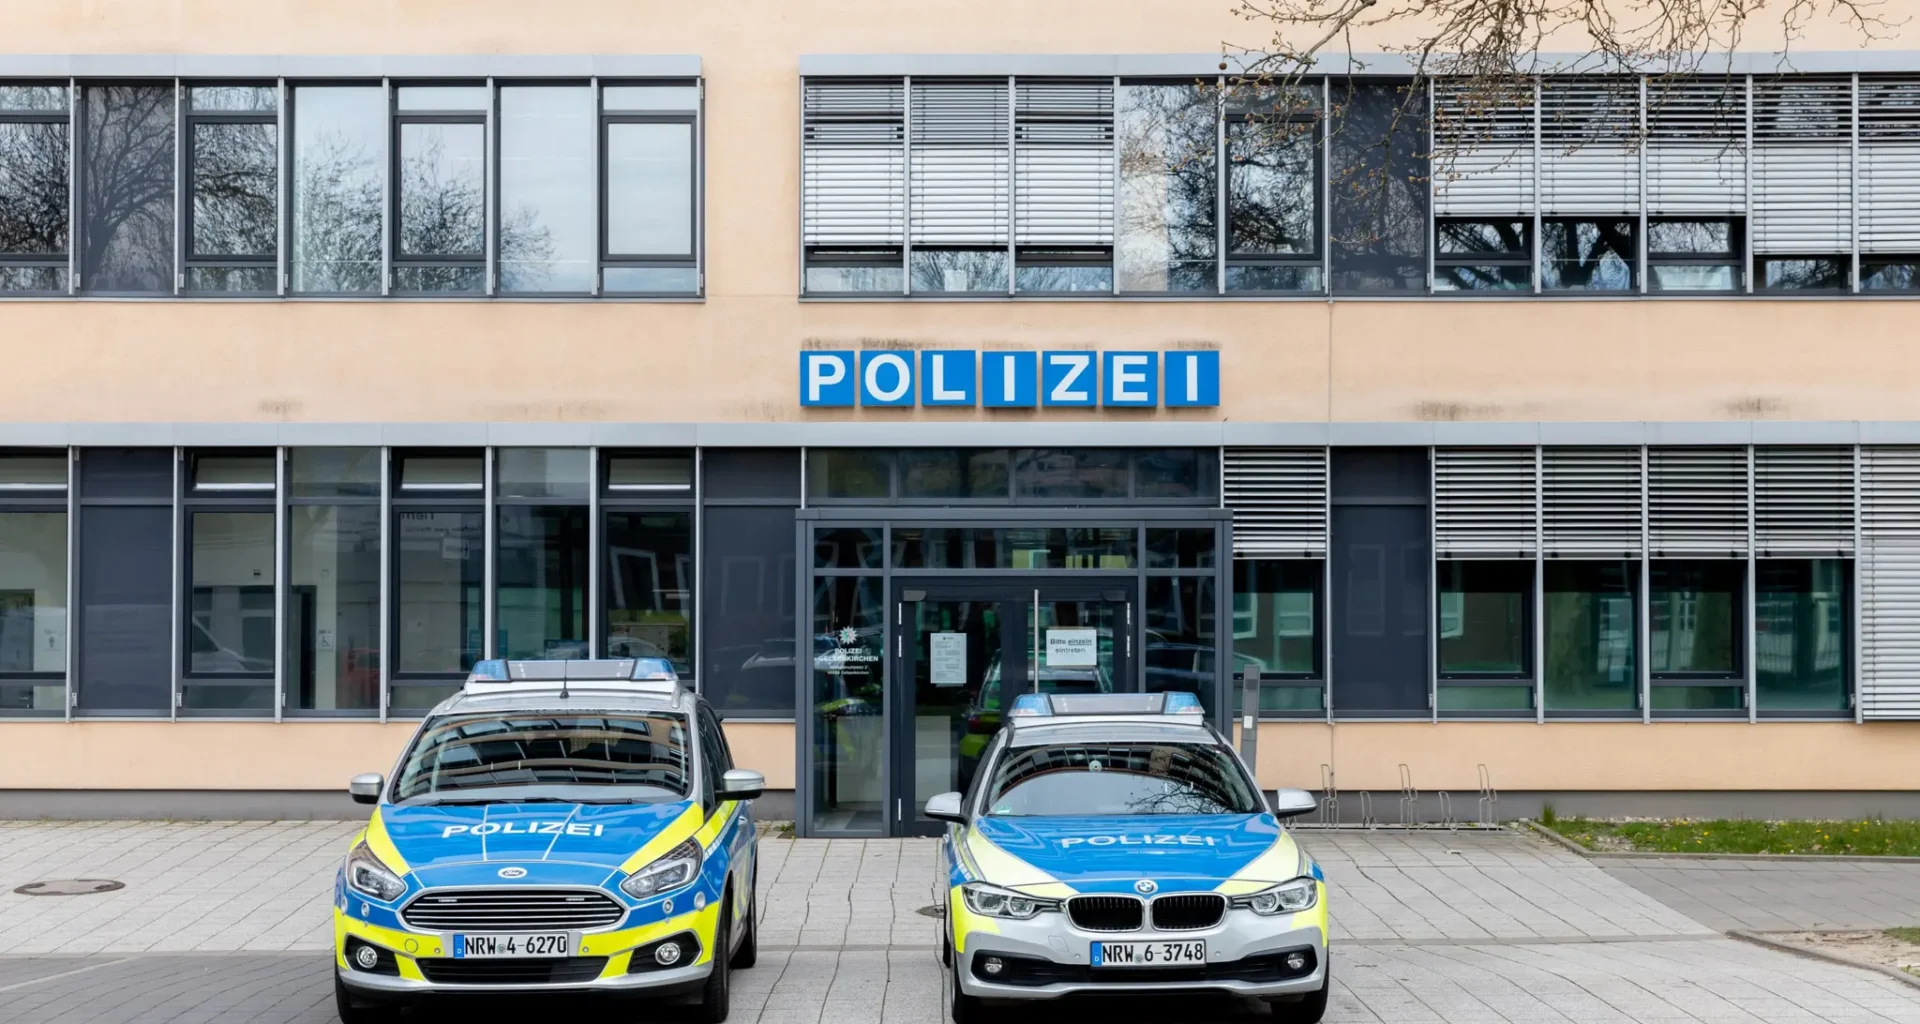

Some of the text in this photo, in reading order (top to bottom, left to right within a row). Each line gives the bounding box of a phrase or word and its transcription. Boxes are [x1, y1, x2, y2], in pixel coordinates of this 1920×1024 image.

[808, 353, 1198, 402] POLIZEI
[1068, 638, 1092, 646] einzeln
[441, 821, 604, 838] POLIZEI
[1061, 834, 1215, 848] POLIZEI
[465, 936, 567, 955] NRW 4-6270
[1102, 943, 1203, 963] NRW 6-3748
